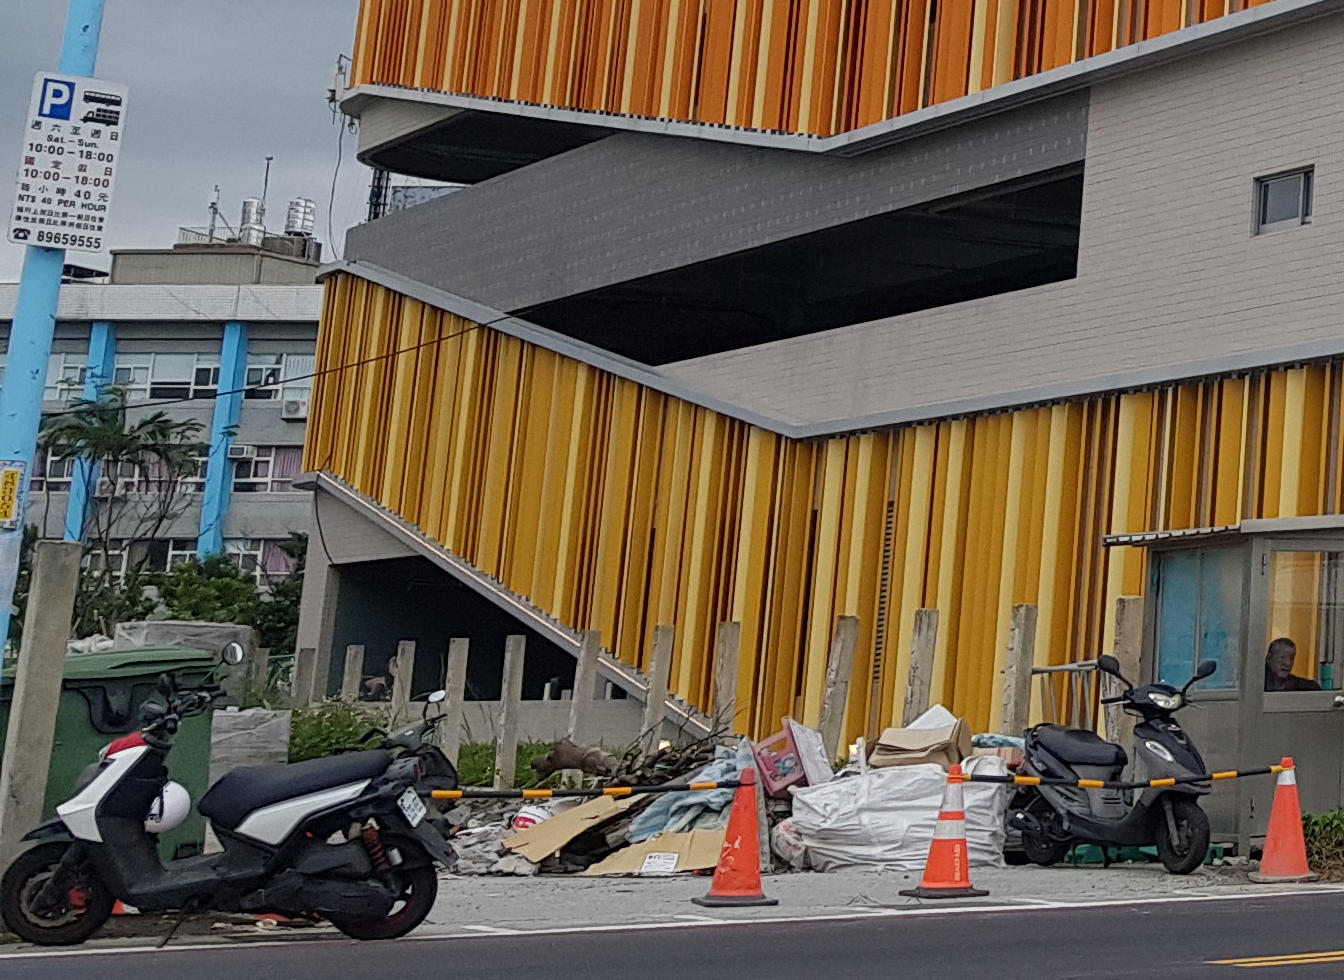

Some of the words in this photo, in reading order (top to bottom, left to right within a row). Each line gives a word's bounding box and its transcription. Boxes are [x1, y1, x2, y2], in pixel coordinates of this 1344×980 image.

[41, 81, 70, 115] P
[57, 199, 76, 208] PER
[81, 202, 106, 212] HOUR
[37, 231, 102, 249] 89659555
